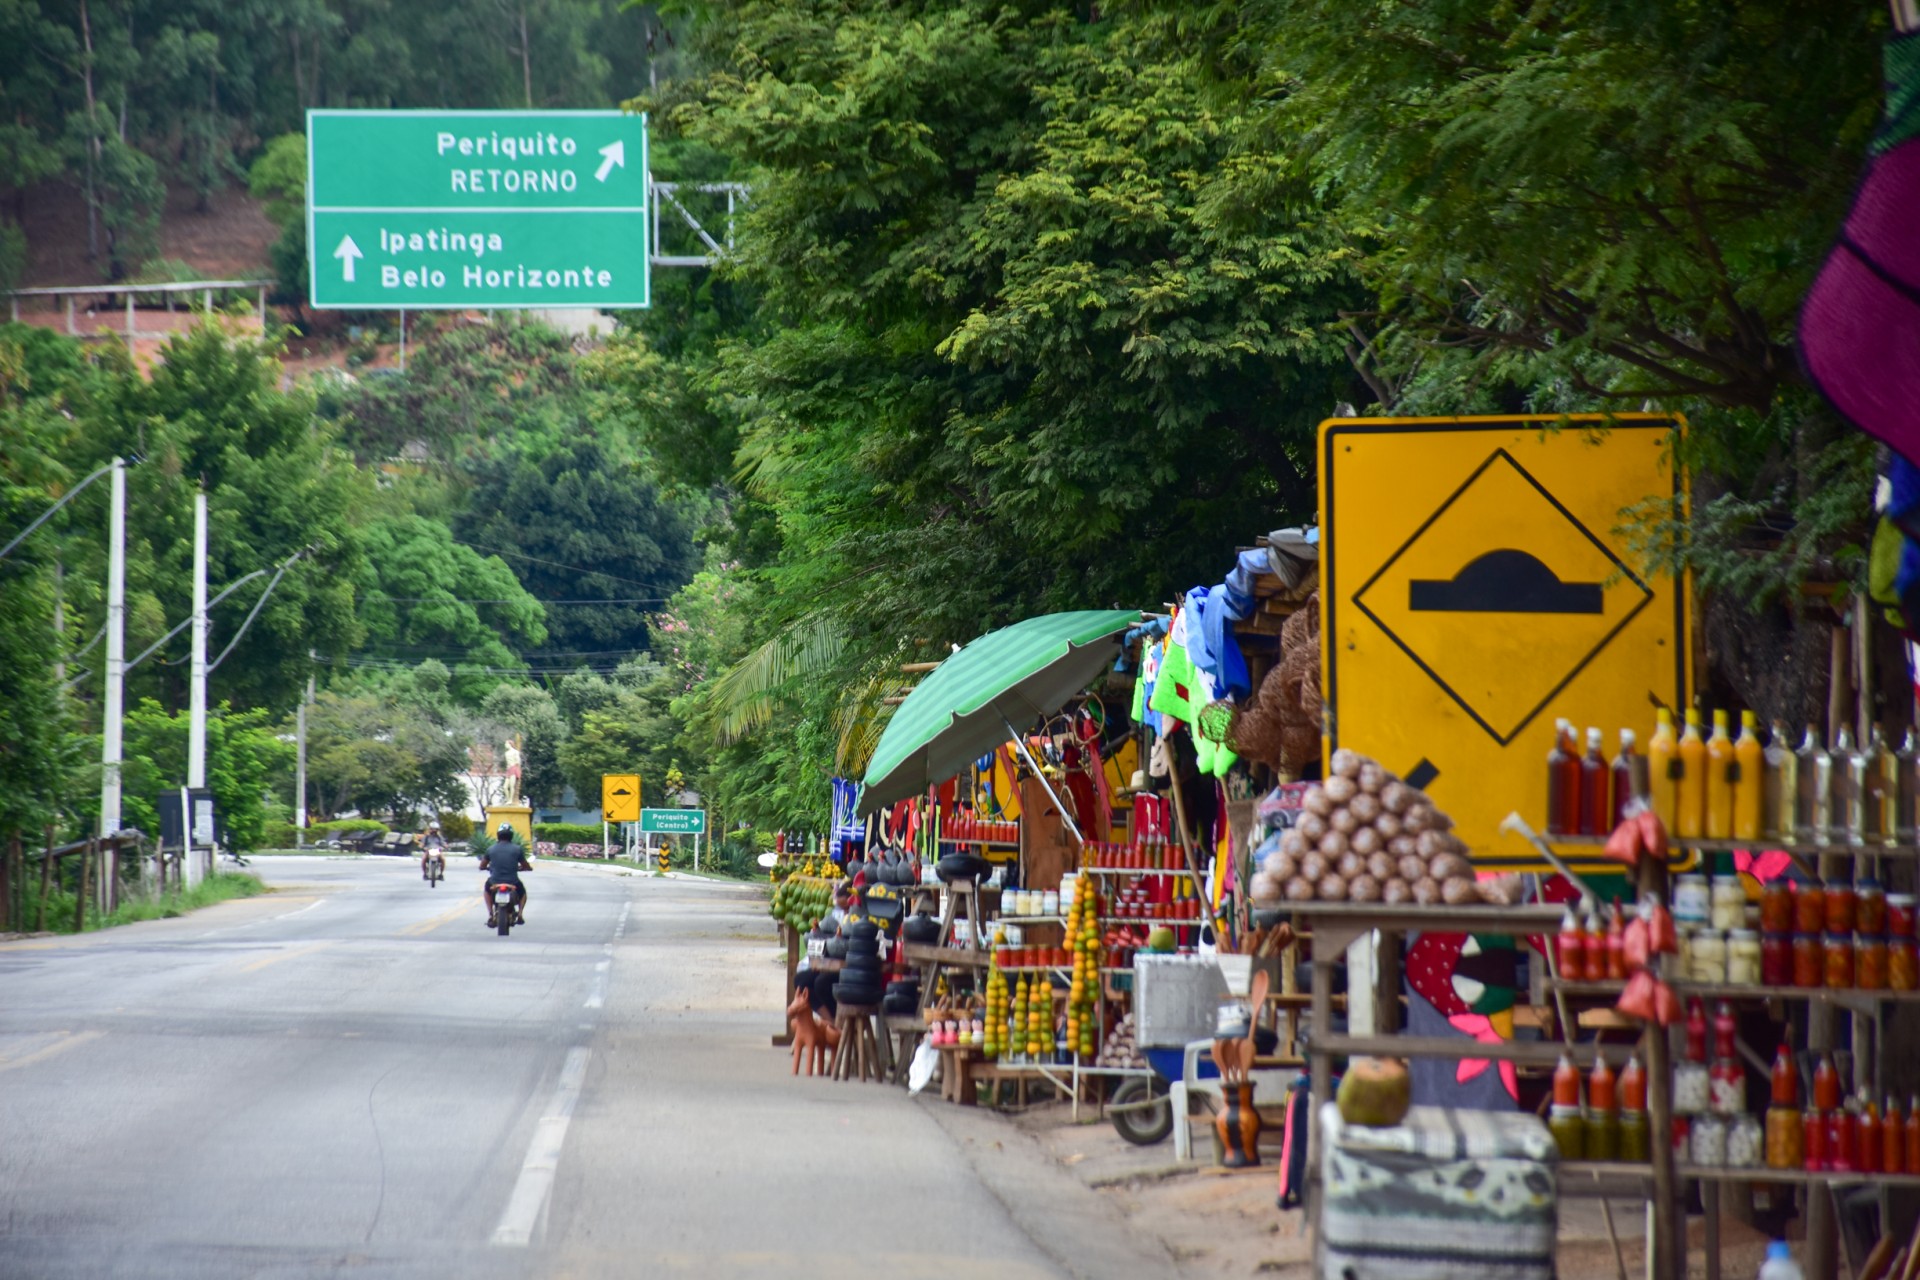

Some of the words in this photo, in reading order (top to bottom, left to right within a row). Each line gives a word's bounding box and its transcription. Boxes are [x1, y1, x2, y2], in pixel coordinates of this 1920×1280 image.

[437, 132, 577, 160] Periquito
[451, 169, 577, 192] RETORNO
[380, 228, 503, 257] Ipatinga
[381, 264, 446, 288] Belo
[463, 264, 612, 288] Horizonte
[652, 813, 689, 821] Periquito
